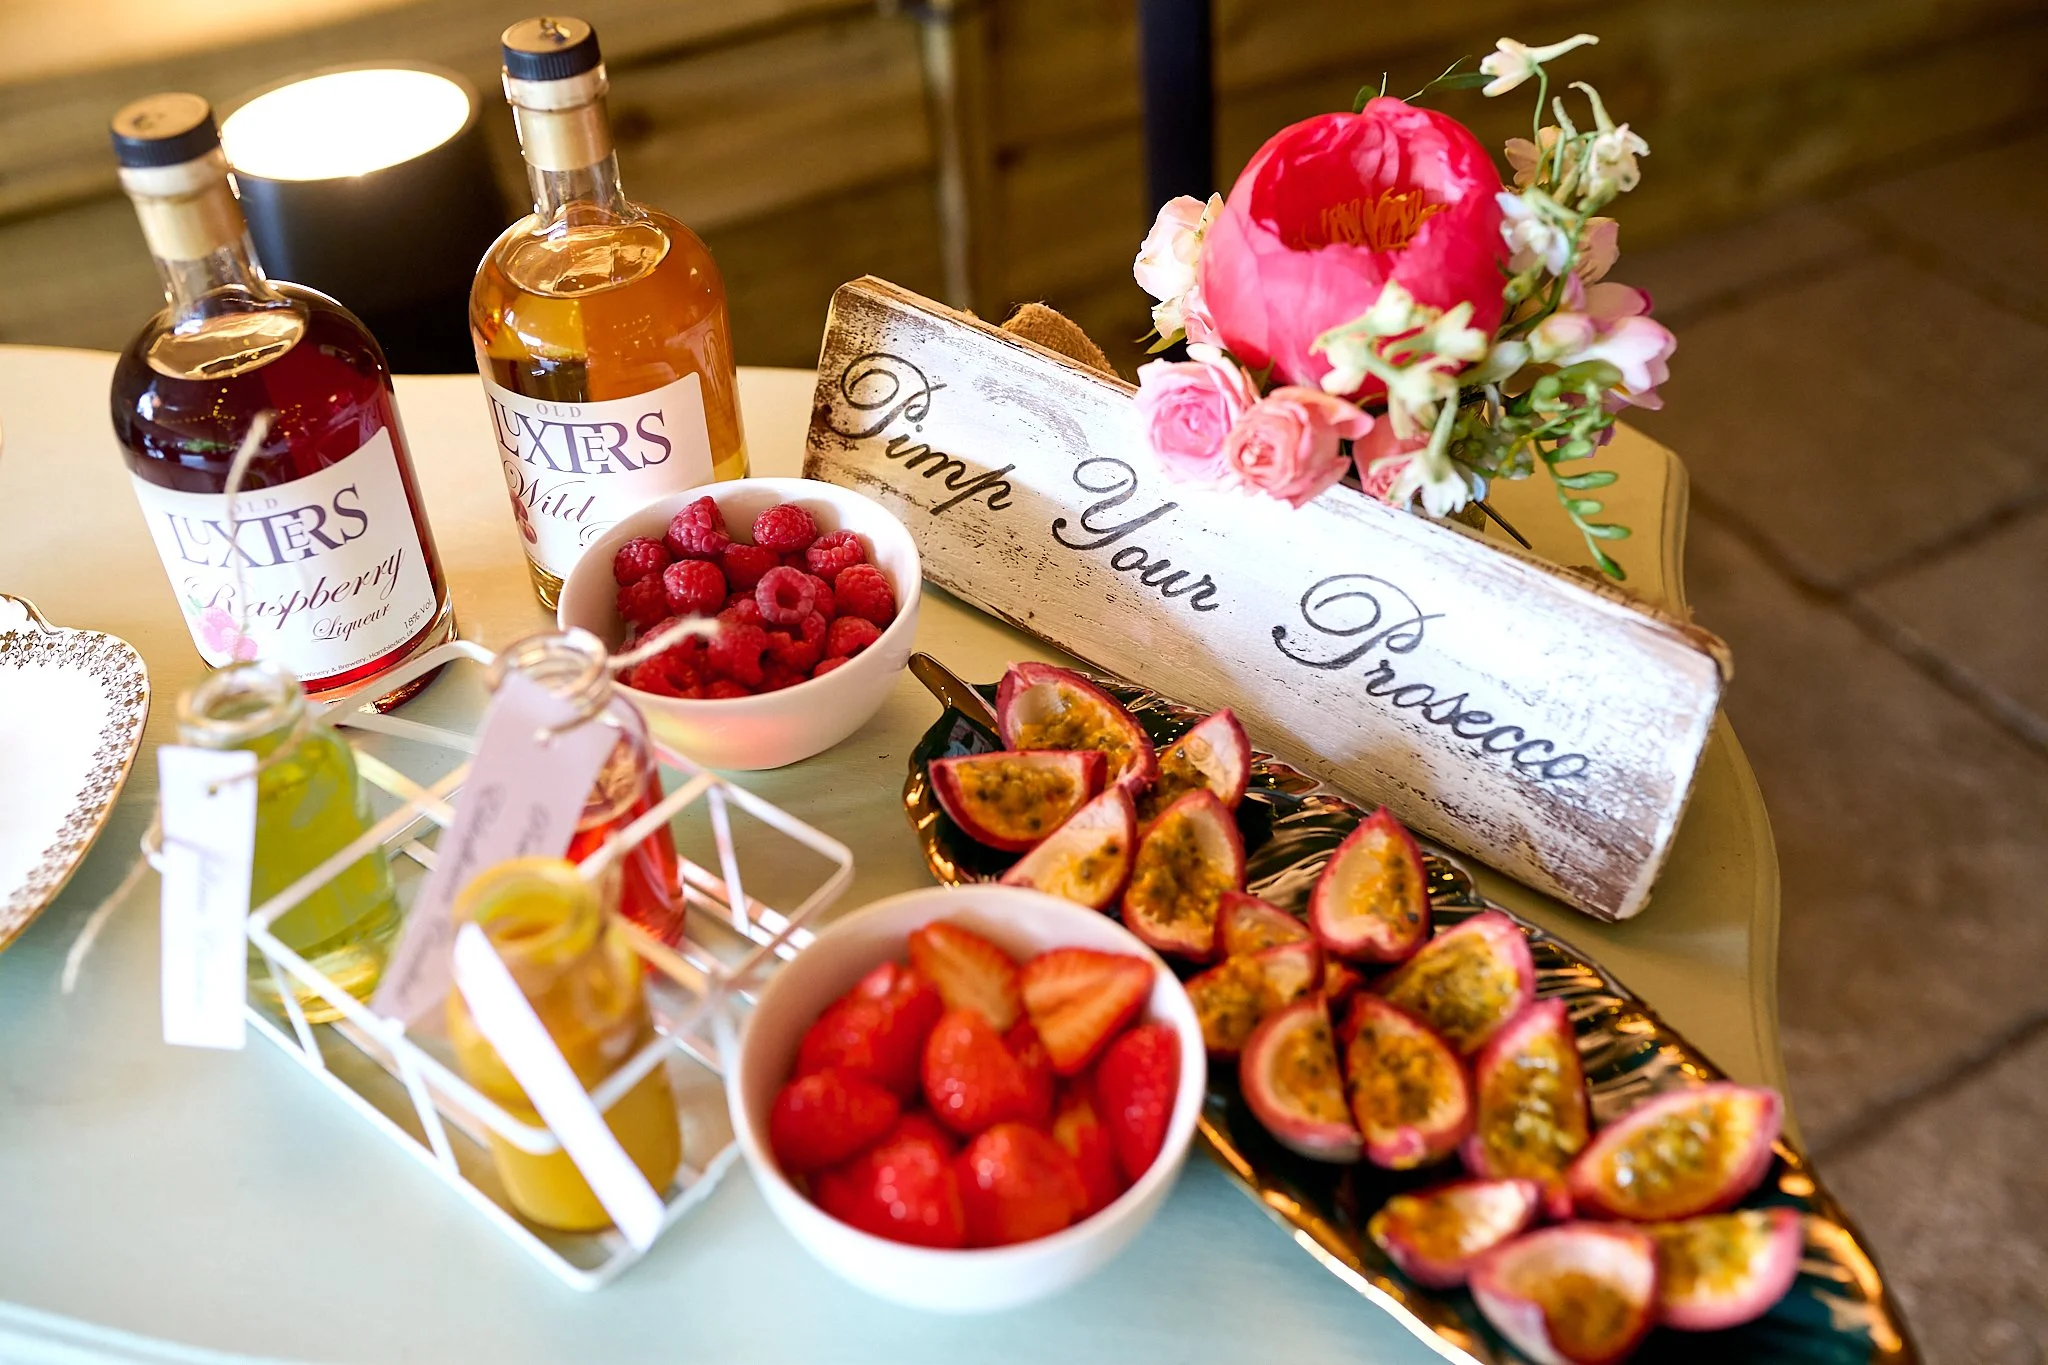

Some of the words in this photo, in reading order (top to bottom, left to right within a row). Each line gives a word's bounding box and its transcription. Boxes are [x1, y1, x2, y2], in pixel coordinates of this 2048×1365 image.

[488, 393, 672, 475] LUXTERS
[536, 402, 582, 418] OLD
[163, 483, 369, 568] LUXTERS
[503, 459, 596, 523] Wild
[183, 546, 405, 630] Raspberry
[819, 352, 1016, 516] Pimp
[1052, 457, 1219, 612] Your
[1271, 573, 1590, 779] Prosecco
[311, 602, 391, 642] Liqueur
[403, 613, 420, 630] 18%
